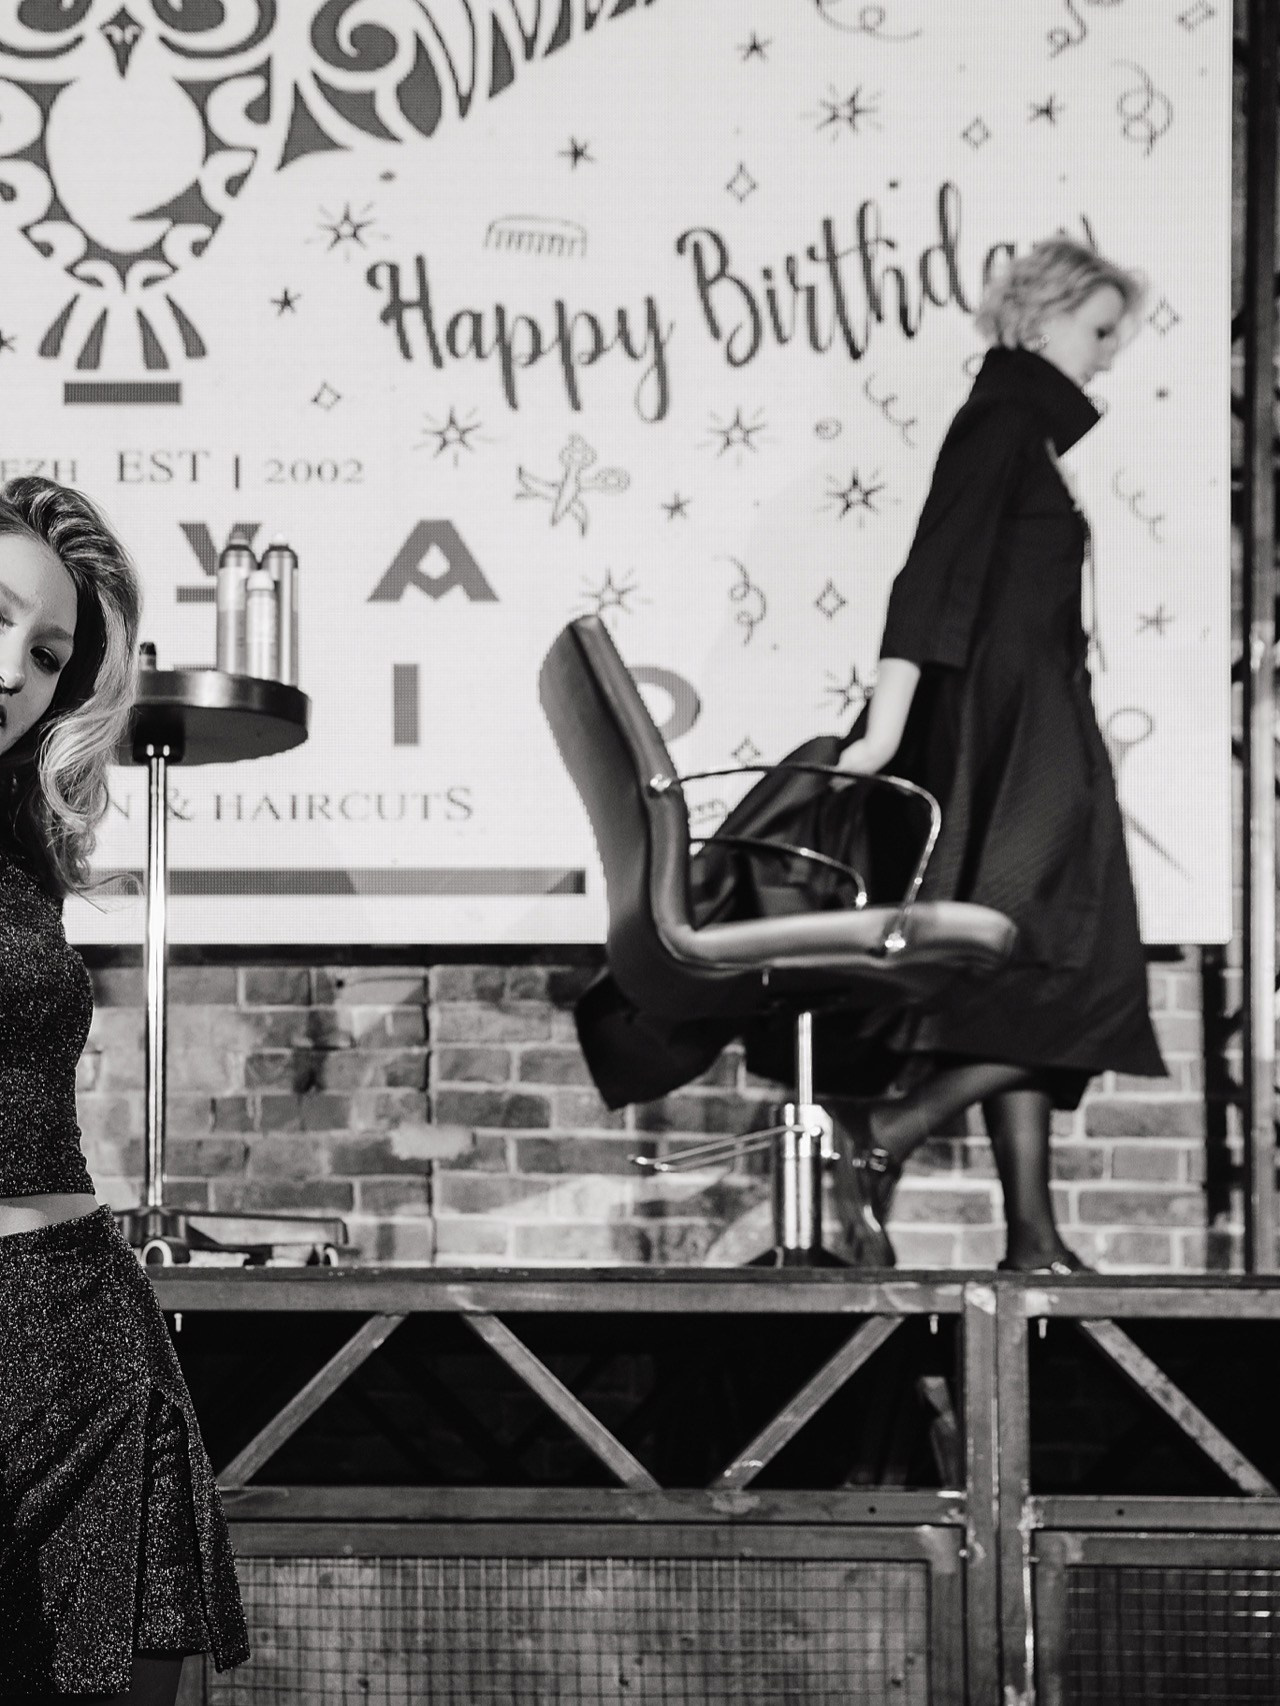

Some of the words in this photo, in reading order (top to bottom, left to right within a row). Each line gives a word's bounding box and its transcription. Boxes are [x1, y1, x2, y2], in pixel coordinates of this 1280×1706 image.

[365, 254, 676, 424] Happy
[676, 180, 1100, 369] Birthd
[117, 450, 209, 484] EST
[265, 460, 364, 484] 2002
[214, 787, 473, 822] HAIRCUTS
